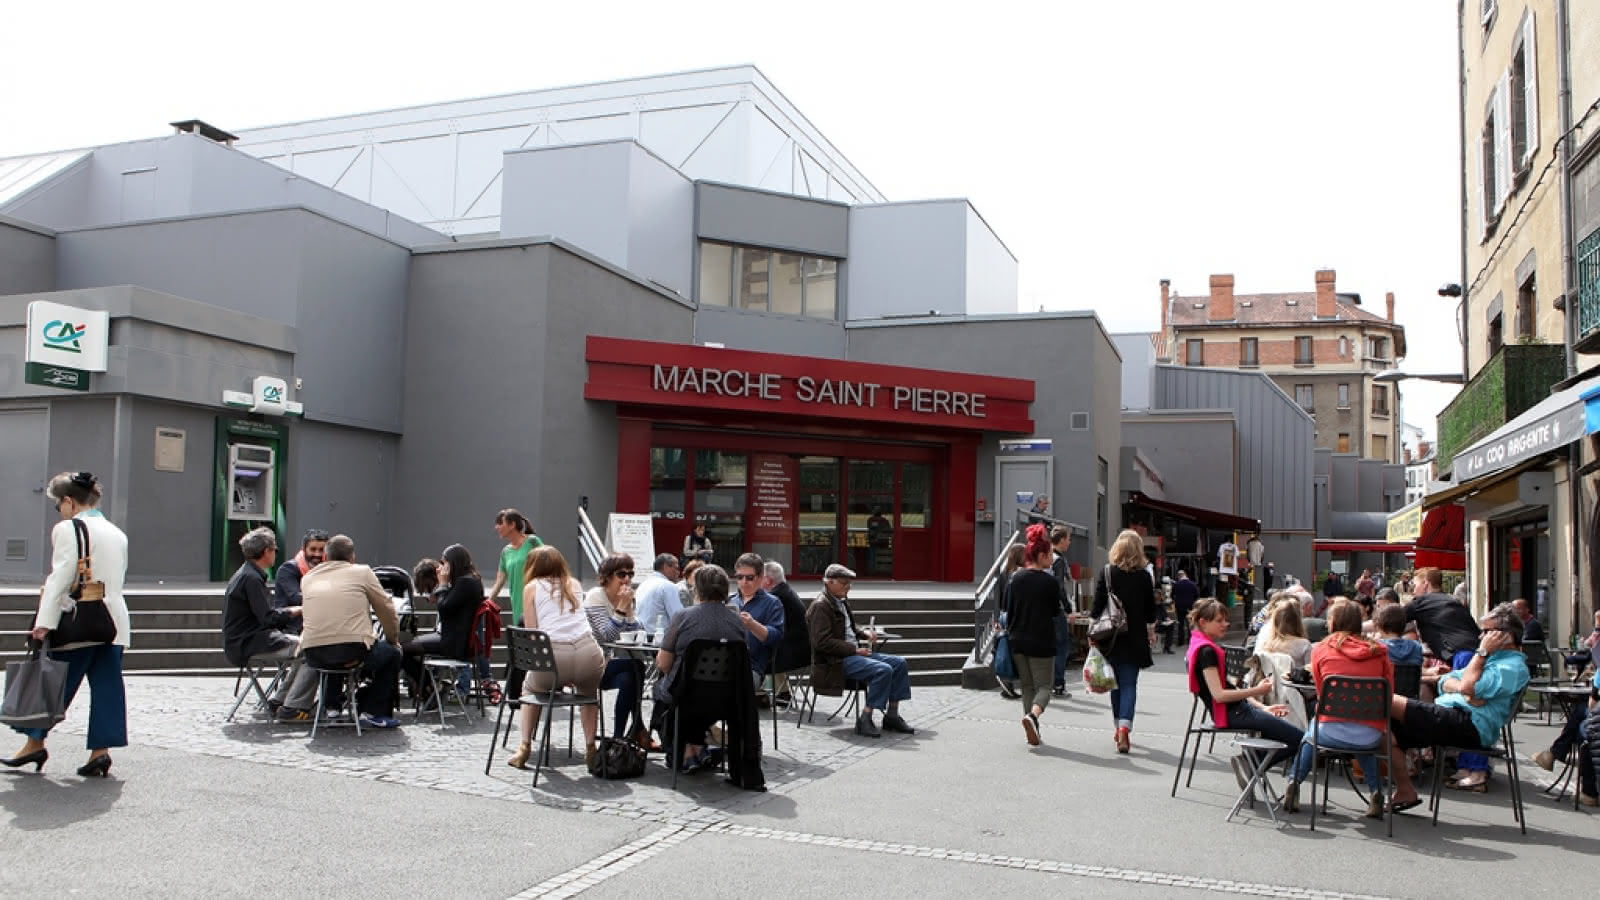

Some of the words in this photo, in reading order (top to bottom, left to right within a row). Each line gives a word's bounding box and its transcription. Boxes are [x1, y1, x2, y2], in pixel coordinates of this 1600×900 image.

[653, 364, 782, 401] MARCHE
[796, 376, 881, 408] SAINT
[893, 385, 987, 419] PIERRE
[1487, 444, 1505, 463] COQ
